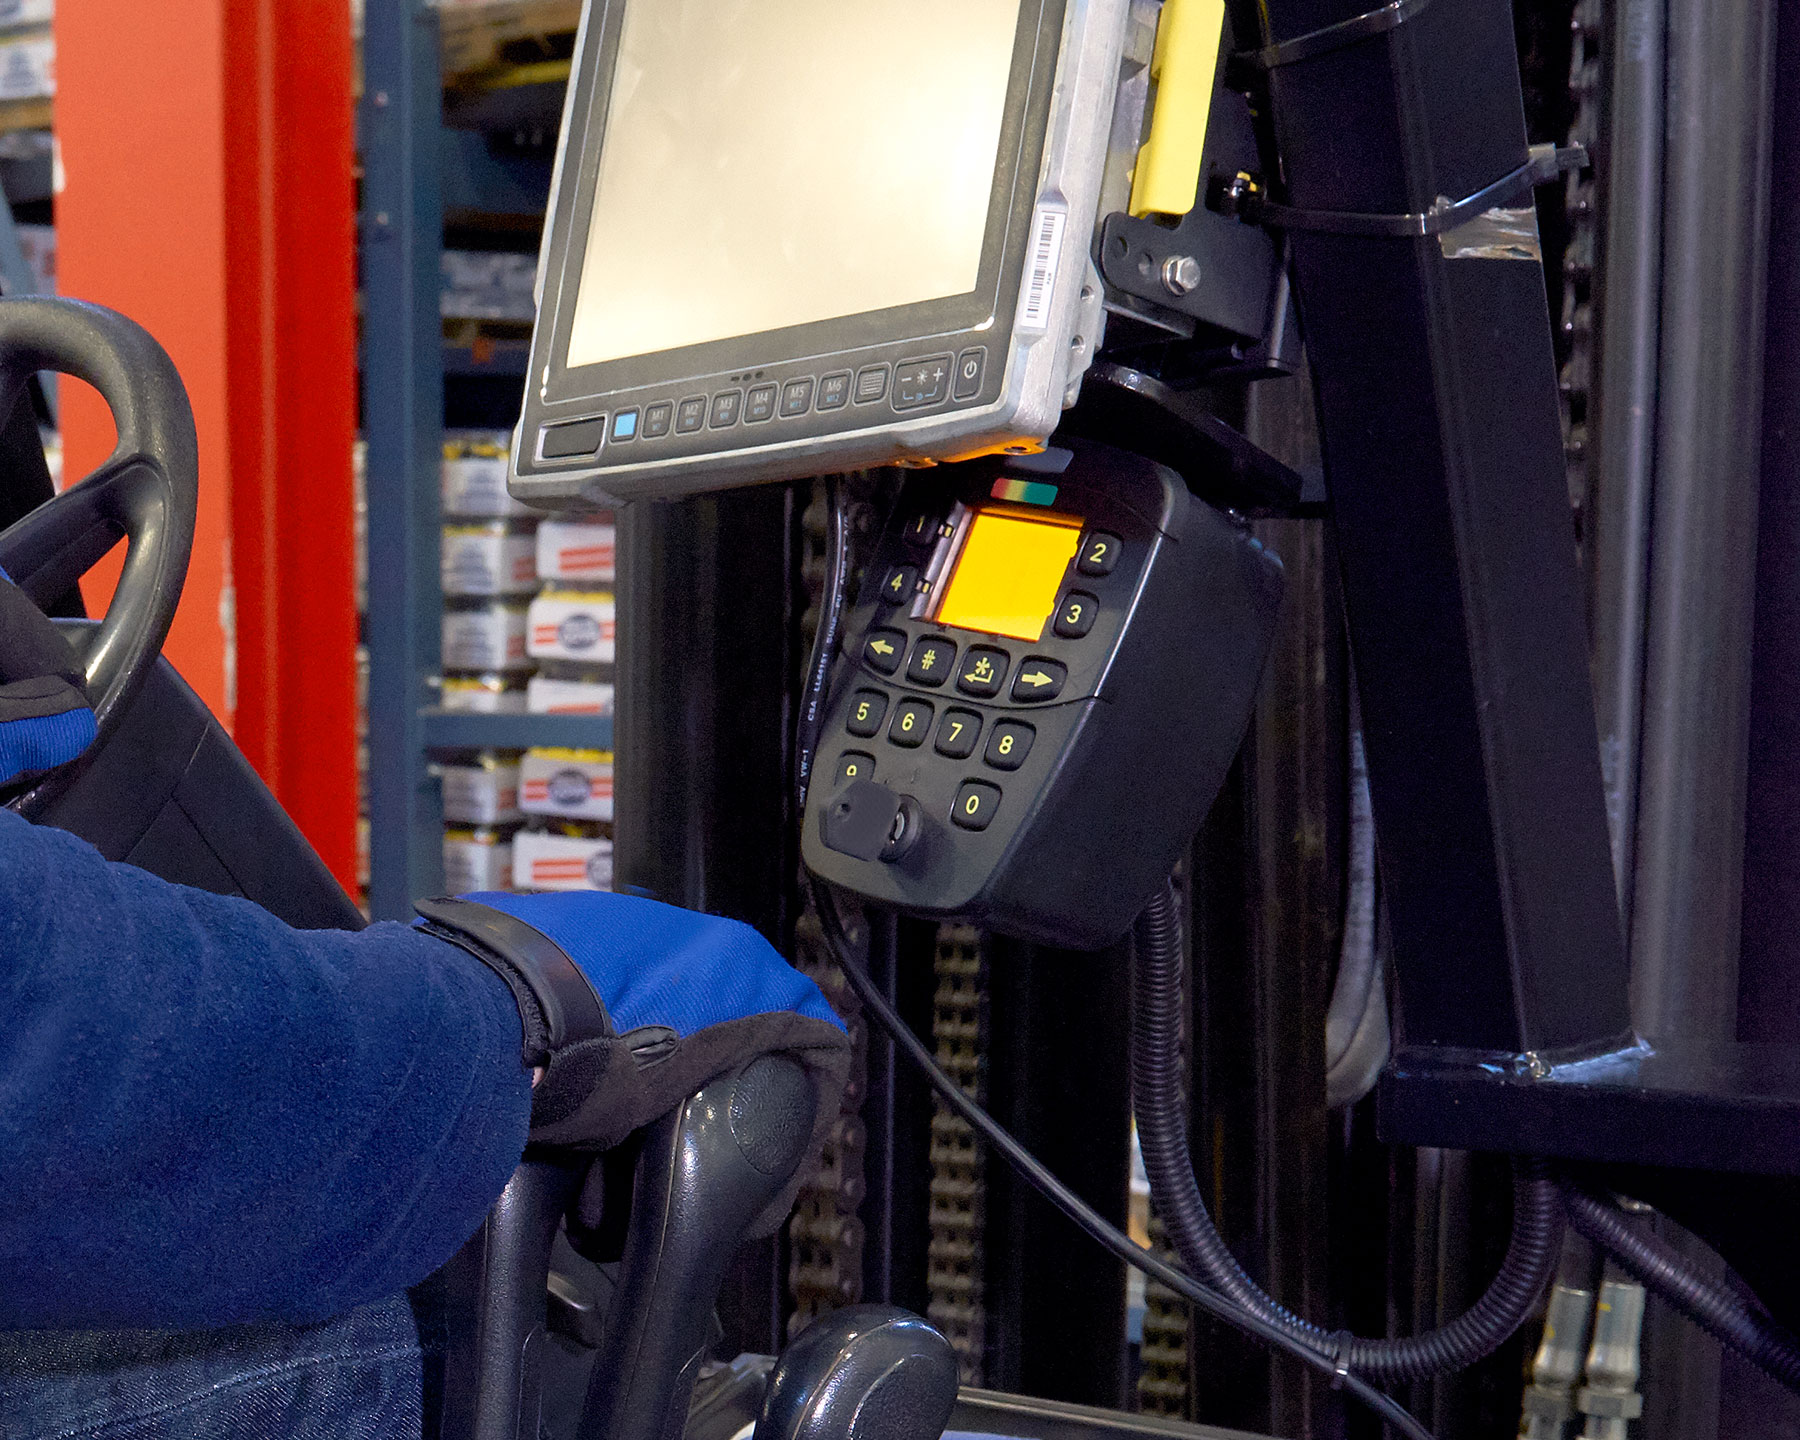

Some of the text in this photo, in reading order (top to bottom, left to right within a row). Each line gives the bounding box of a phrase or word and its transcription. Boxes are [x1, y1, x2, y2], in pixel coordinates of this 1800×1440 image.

[790, 387, 804, 399] M5
[827, 380, 842, 392] M6
[719, 398, 733, 410] M3
[755, 392, 768, 404] M4
[685, 404, 699, 416] M2
[916, 515, 925, 533] 1
[1089, 543, 1107, 563] 2
[891, 574, 903, 592] 4
[1066, 604, 1082, 624] 3
[807, 700, 817, 721] CSA
[857, 702, 1014, 754] 5 6 7 8
[965, 795, 980, 815] 0
